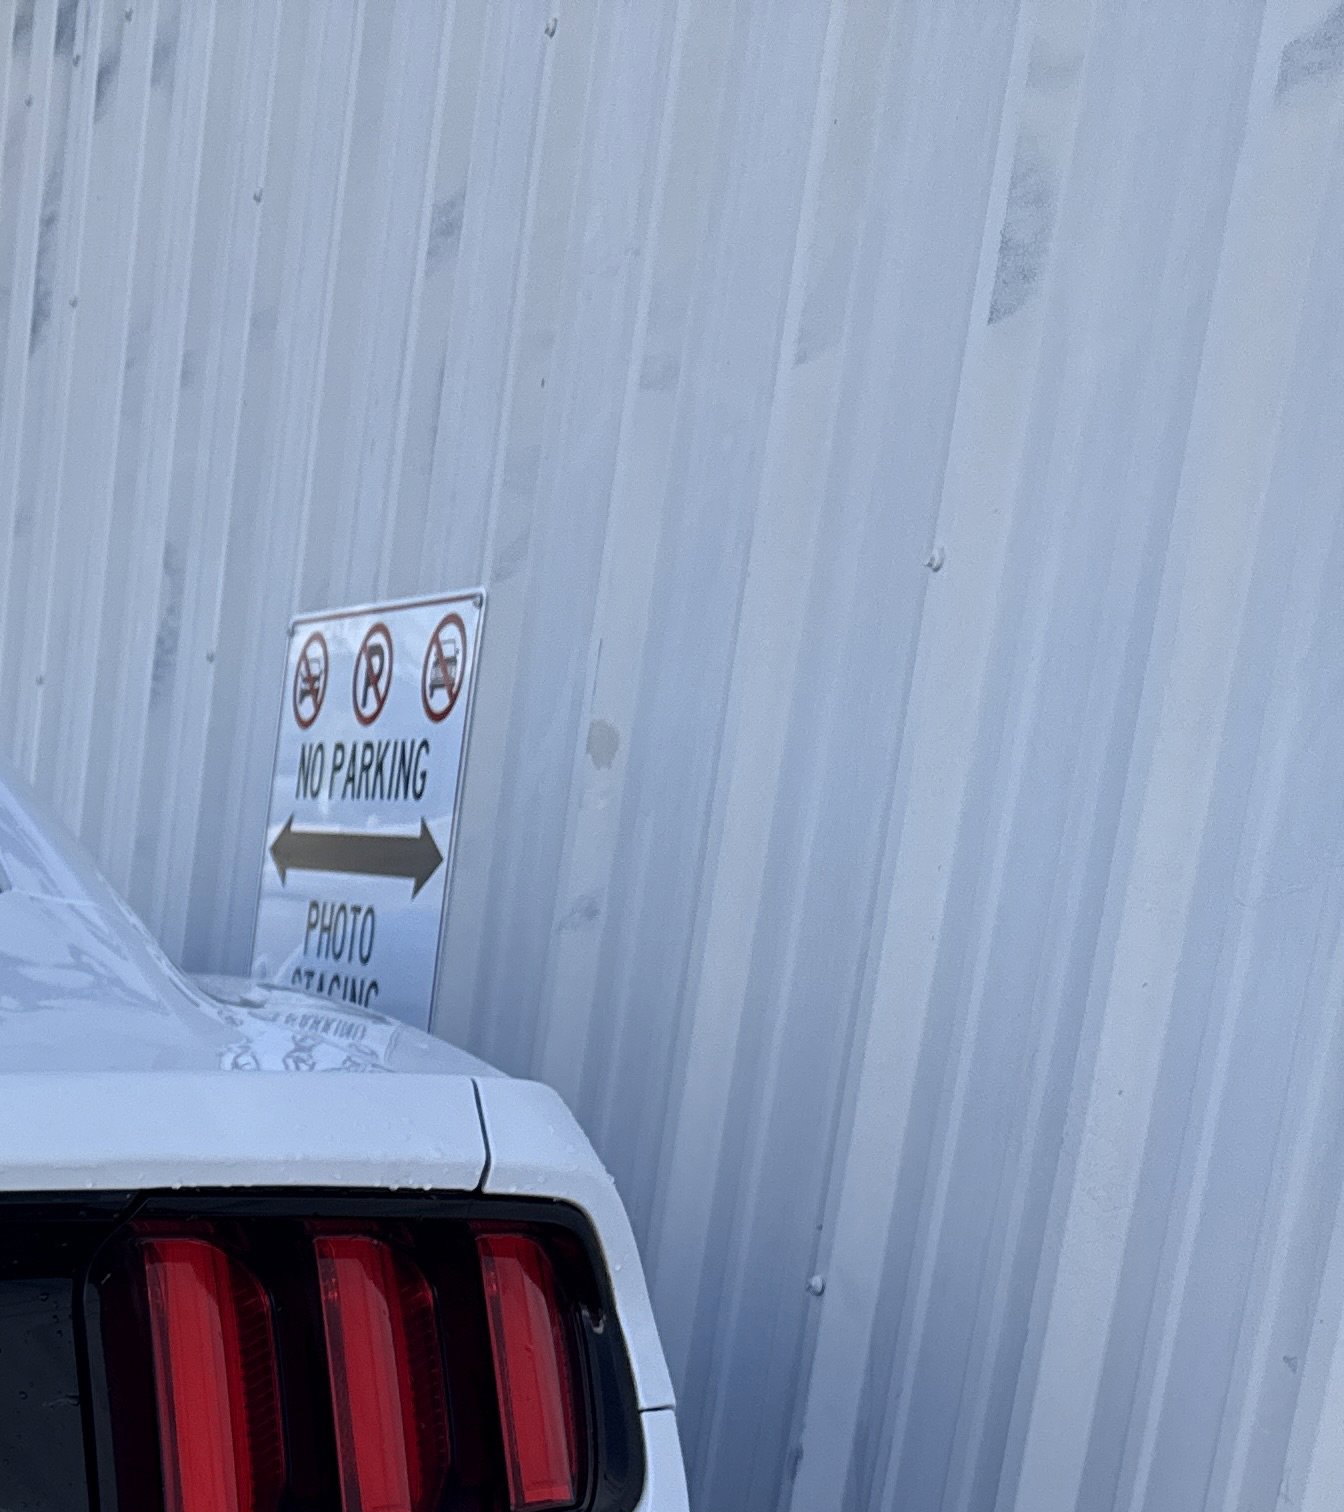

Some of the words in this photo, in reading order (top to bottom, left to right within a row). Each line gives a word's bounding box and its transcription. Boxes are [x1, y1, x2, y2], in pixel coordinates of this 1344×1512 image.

[295, 742, 325, 800] NO
[328, 738, 430, 801] PARKING
[304, 900, 376, 965] PHOTO
